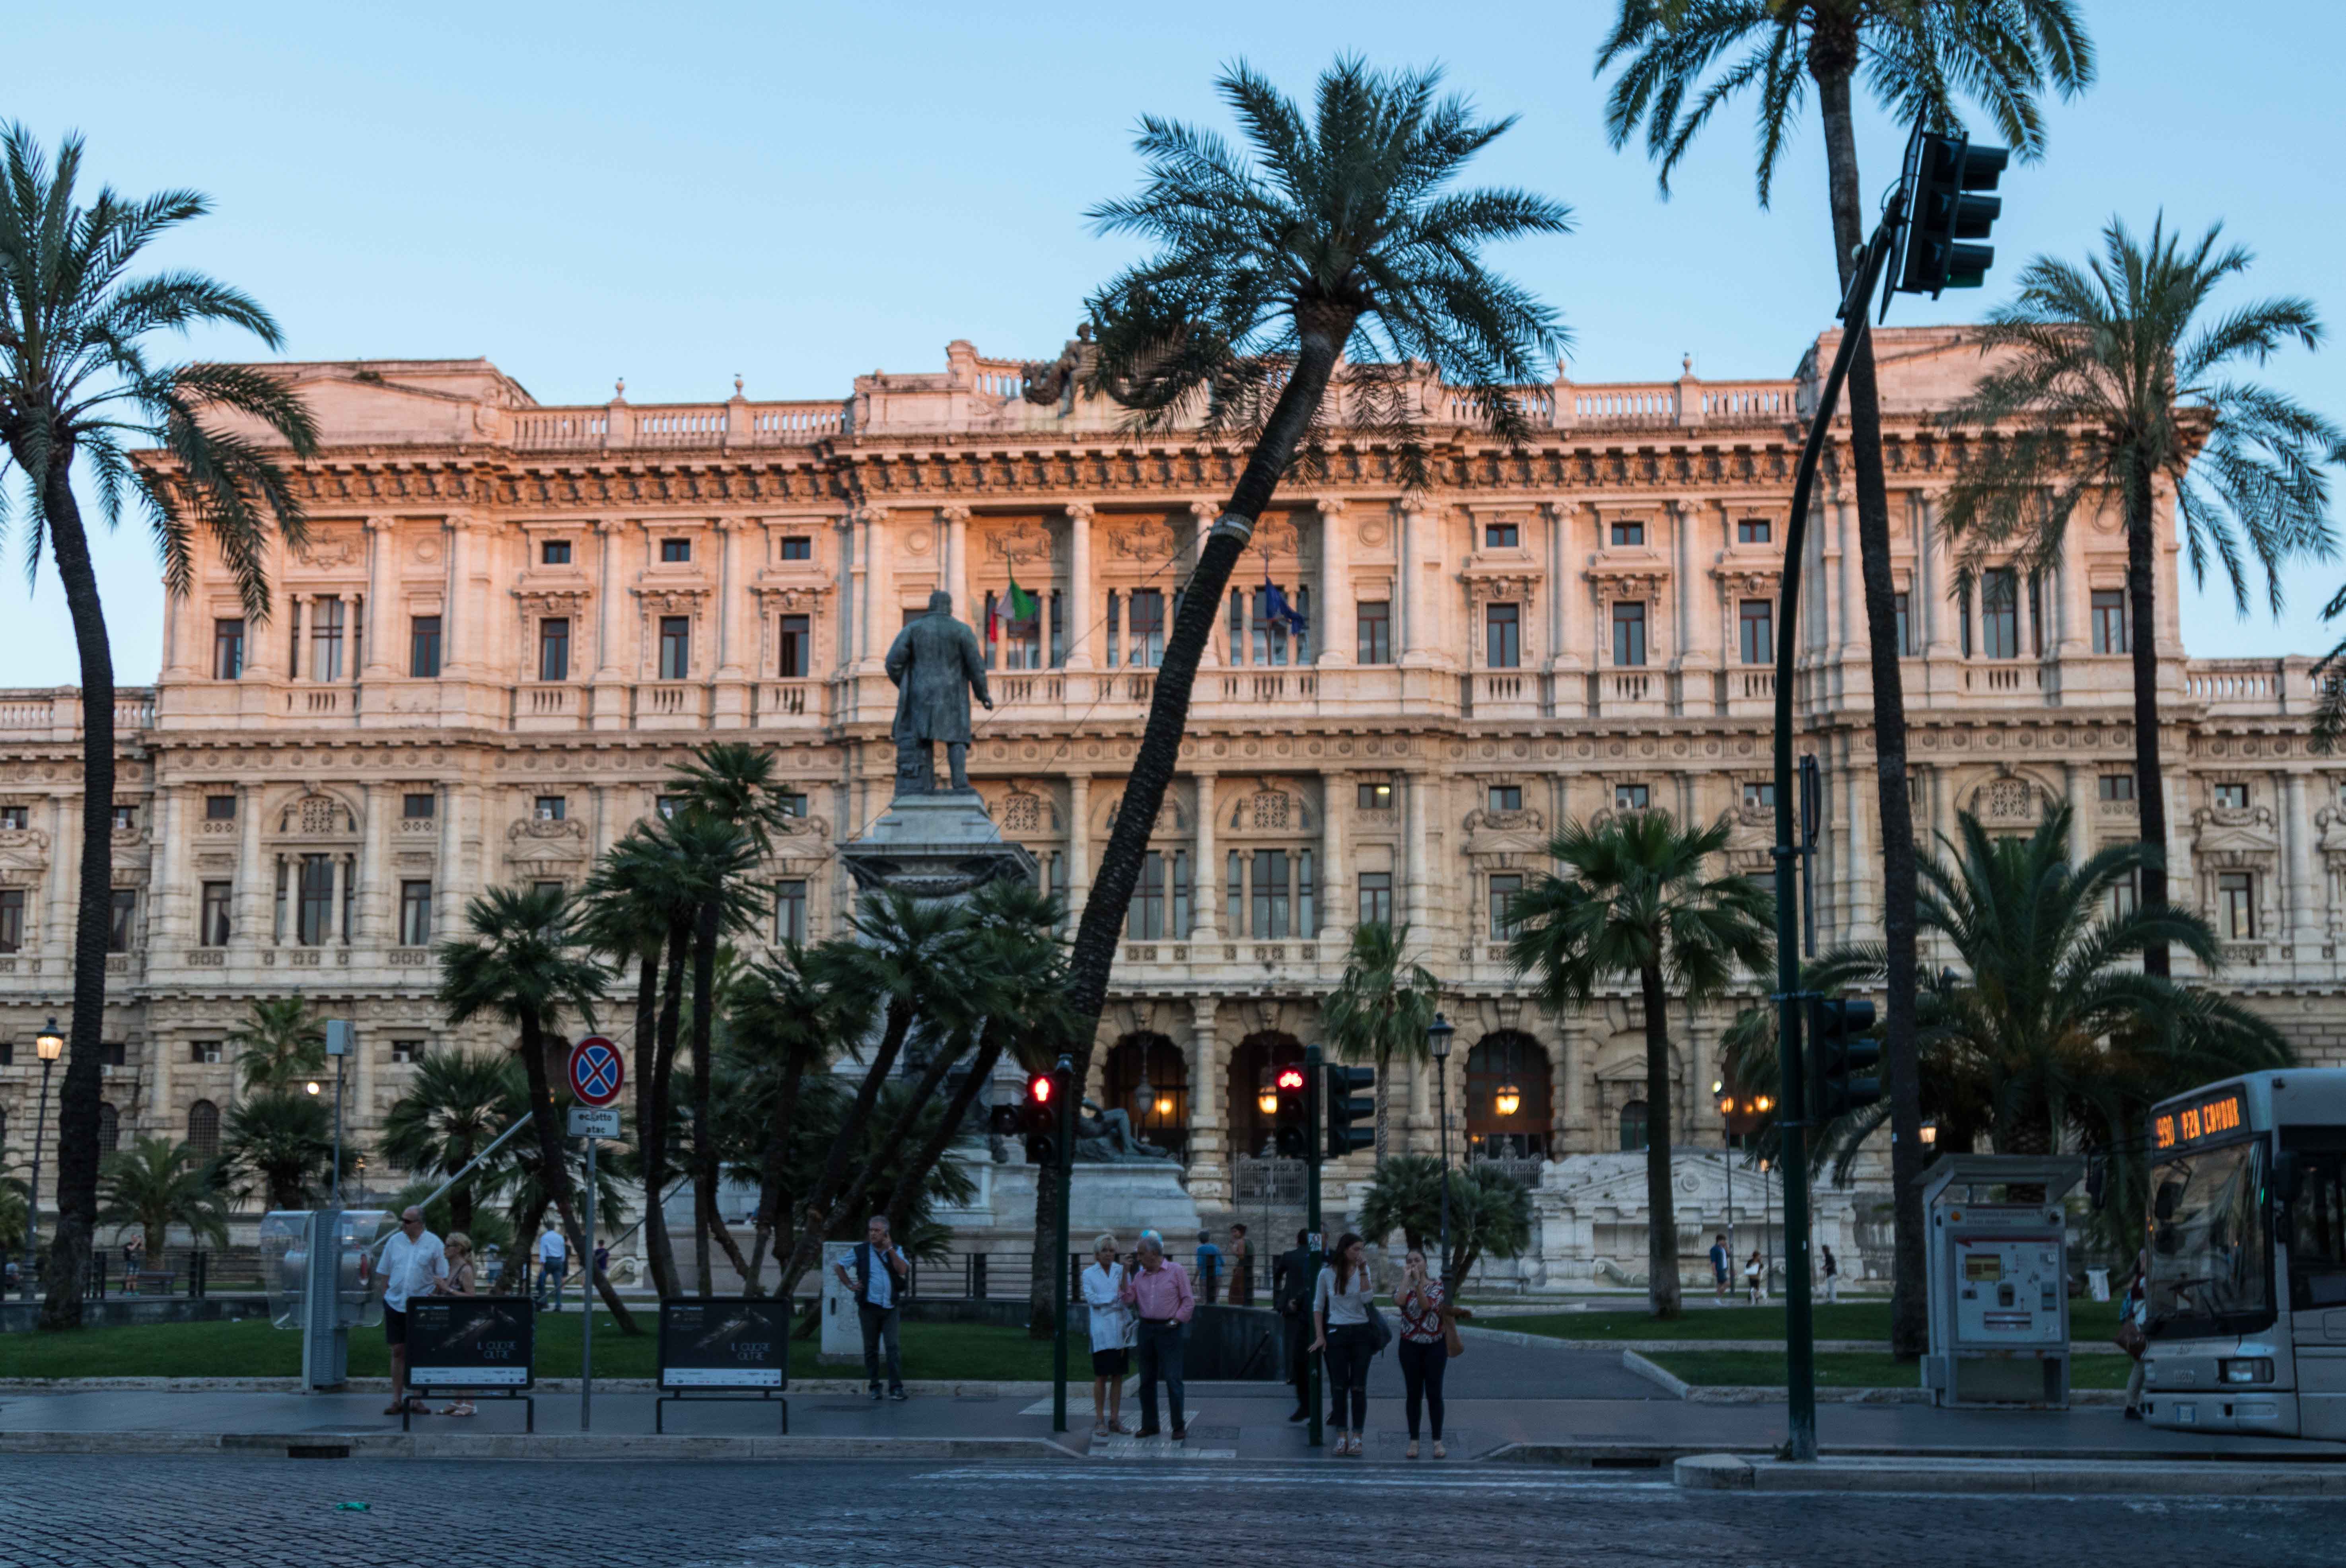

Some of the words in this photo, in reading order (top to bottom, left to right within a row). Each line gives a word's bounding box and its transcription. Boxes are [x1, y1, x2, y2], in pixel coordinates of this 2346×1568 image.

[586, 1125, 605, 1134] atac
[2156, 1114, 2175, 1149] 990
[2181, 1108, 2200, 1140] PZA
[2202, 1096, 2240, 1135] CAVOUR
